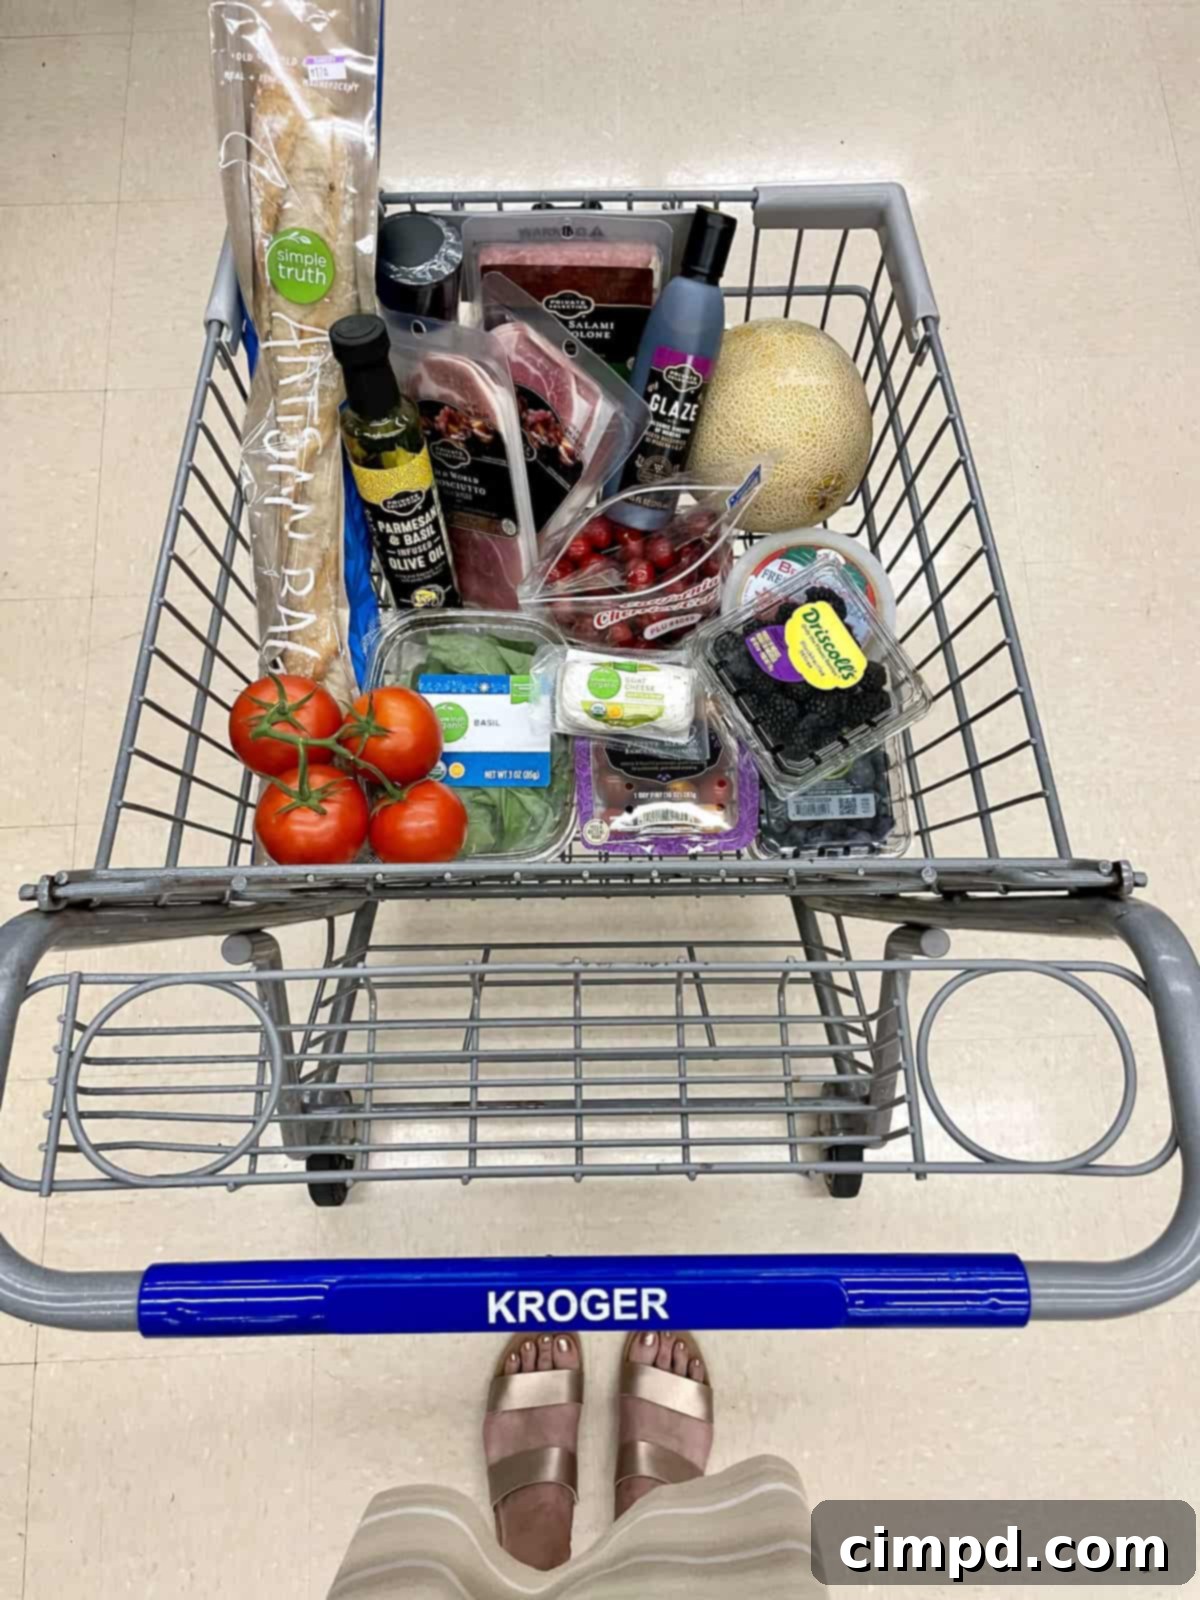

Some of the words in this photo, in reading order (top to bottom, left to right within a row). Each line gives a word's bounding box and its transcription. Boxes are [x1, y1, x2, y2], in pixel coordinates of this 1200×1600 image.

[277, 248, 327, 269] simple
[278, 262, 327, 285] truth
[568, 320, 615, 330] SALAMI
[571, 331, 611, 339] OLONE
[650, 393, 699, 422] GLAZE
[438, 479, 487, 496] OSCIUTTO
[377, 505, 438, 534] PARMESAN
[404, 525, 436, 546] BASIL
[388, 555, 426, 571] OLIVE
[428, 546, 445, 563] OIL
[761, 568, 784, 584] FRE
[802, 608, 857, 681] Driscoll's
[474, 719, 500, 727] BASIL
[488, 1288, 669, 1324] KROGER
